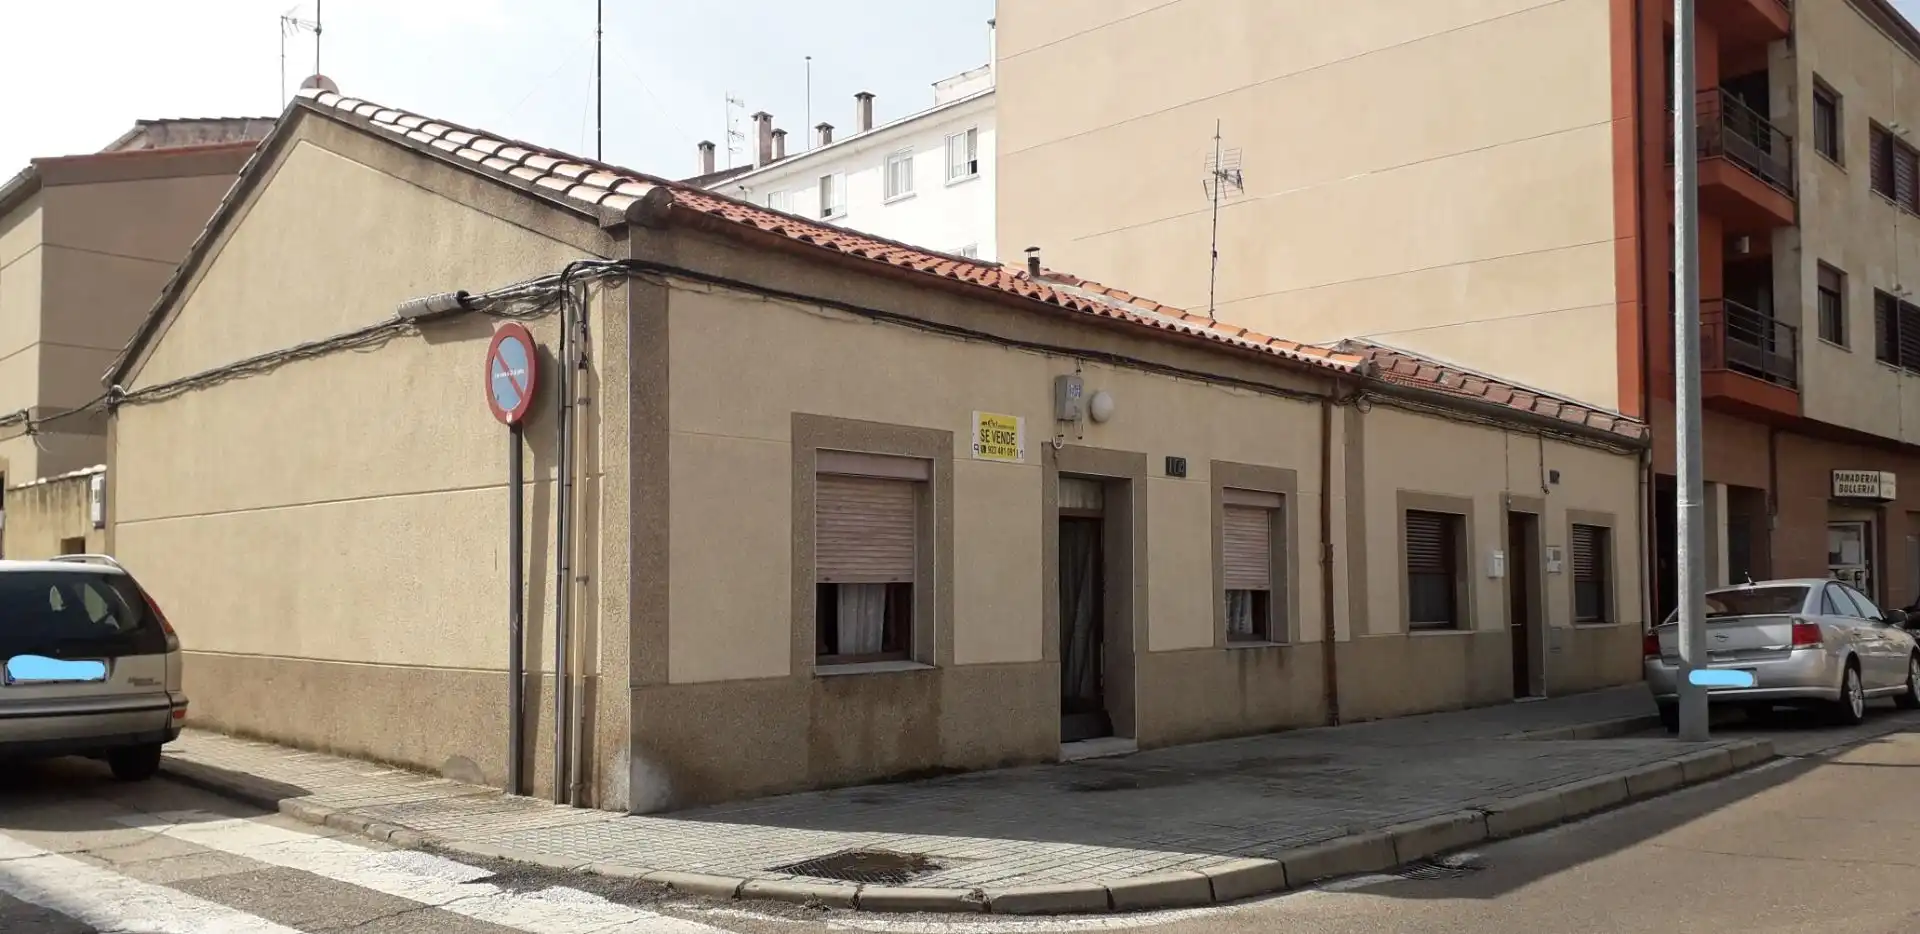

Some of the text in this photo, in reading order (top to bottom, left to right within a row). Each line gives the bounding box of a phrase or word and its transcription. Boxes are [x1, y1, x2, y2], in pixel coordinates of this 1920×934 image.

[980, 428, 1016, 446] SE VENDE
[1834, 472, 1878, 483] PANADERIA
